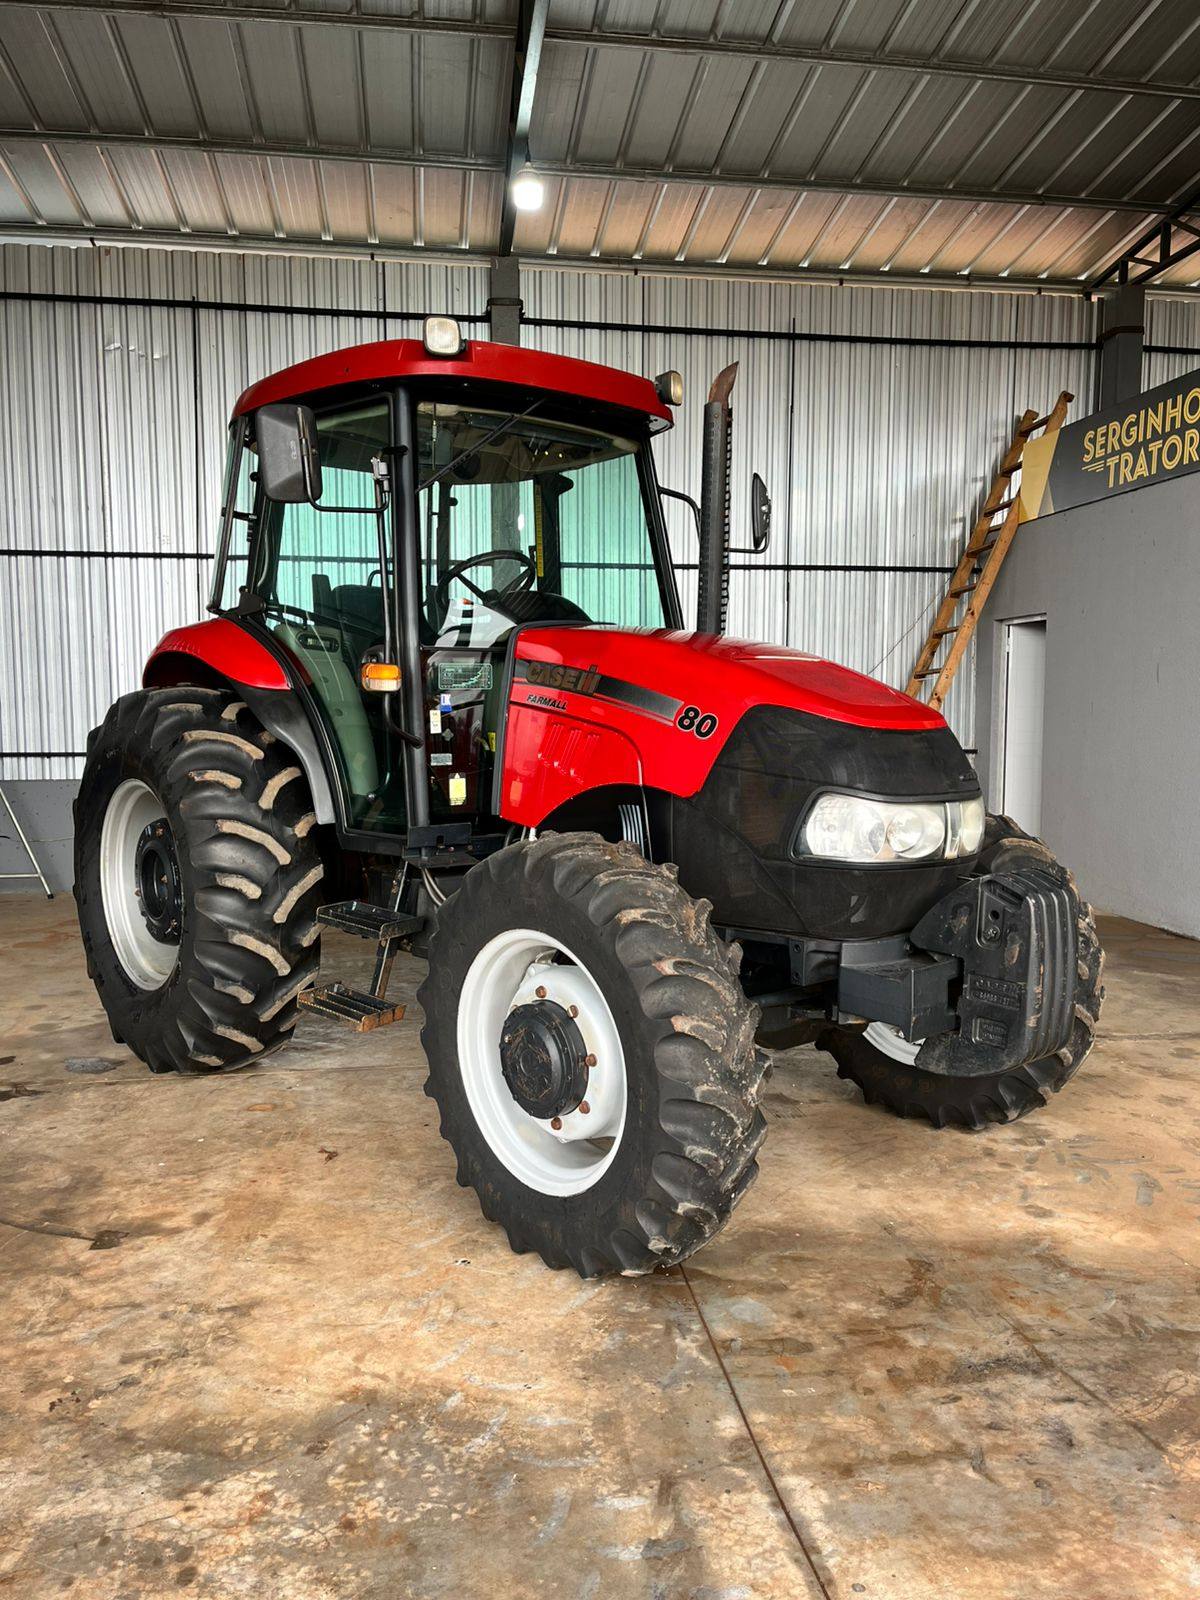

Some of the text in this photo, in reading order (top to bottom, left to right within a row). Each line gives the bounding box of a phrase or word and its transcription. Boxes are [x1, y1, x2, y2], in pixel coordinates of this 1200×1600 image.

[1082, 387, 1200, 462] SERGINHO
[526, 661, 579, 689] CASE
[526, 694, 568, 711] FARMALL
[676, 705, 719, 739] 80
